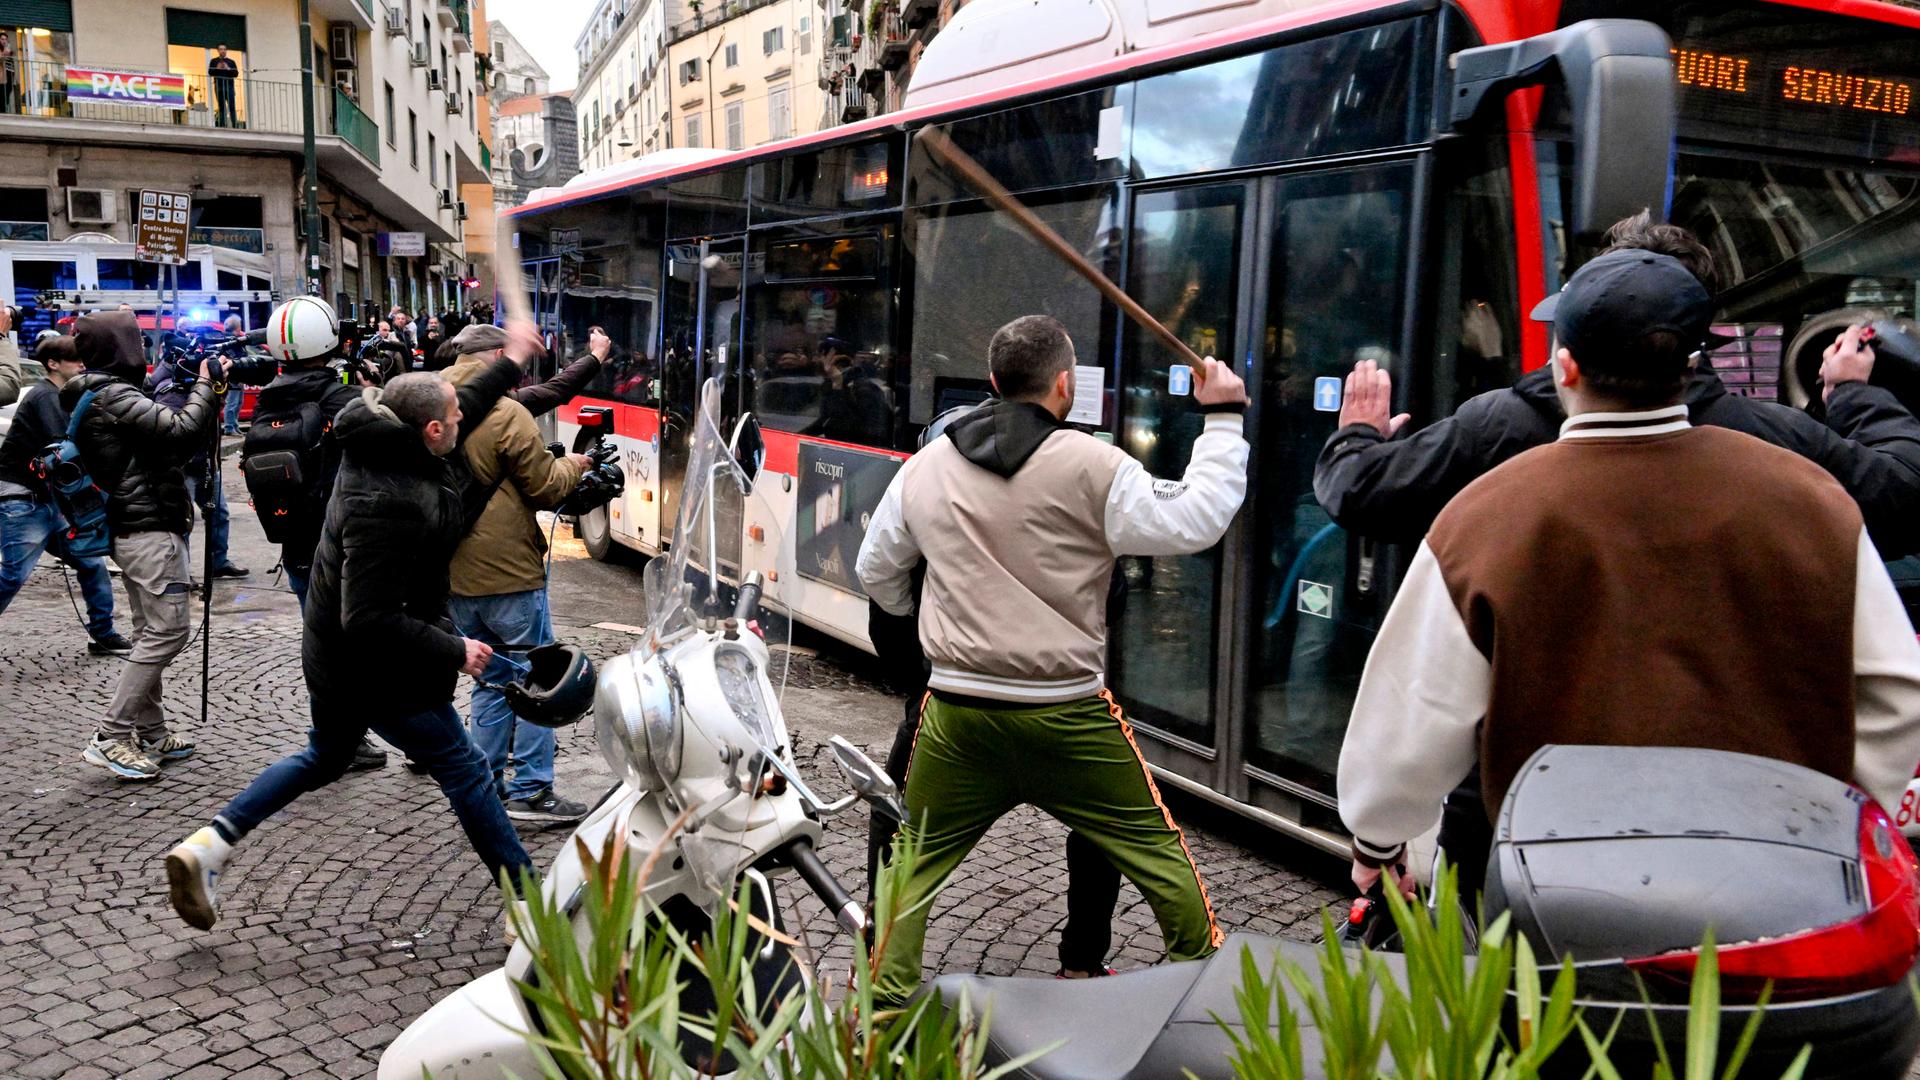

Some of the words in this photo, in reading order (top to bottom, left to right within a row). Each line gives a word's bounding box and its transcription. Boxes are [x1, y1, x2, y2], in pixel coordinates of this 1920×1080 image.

[91, 73, 162, 100] PACE
[1670, 48, 1748, 92] UORI
[1783, 66, 1910, 114] SERVIZIO
[143, 224, 162, 232] Centro
[163, 226, 183, 234] Storico
[815, 458, 844, 480] riscopri
